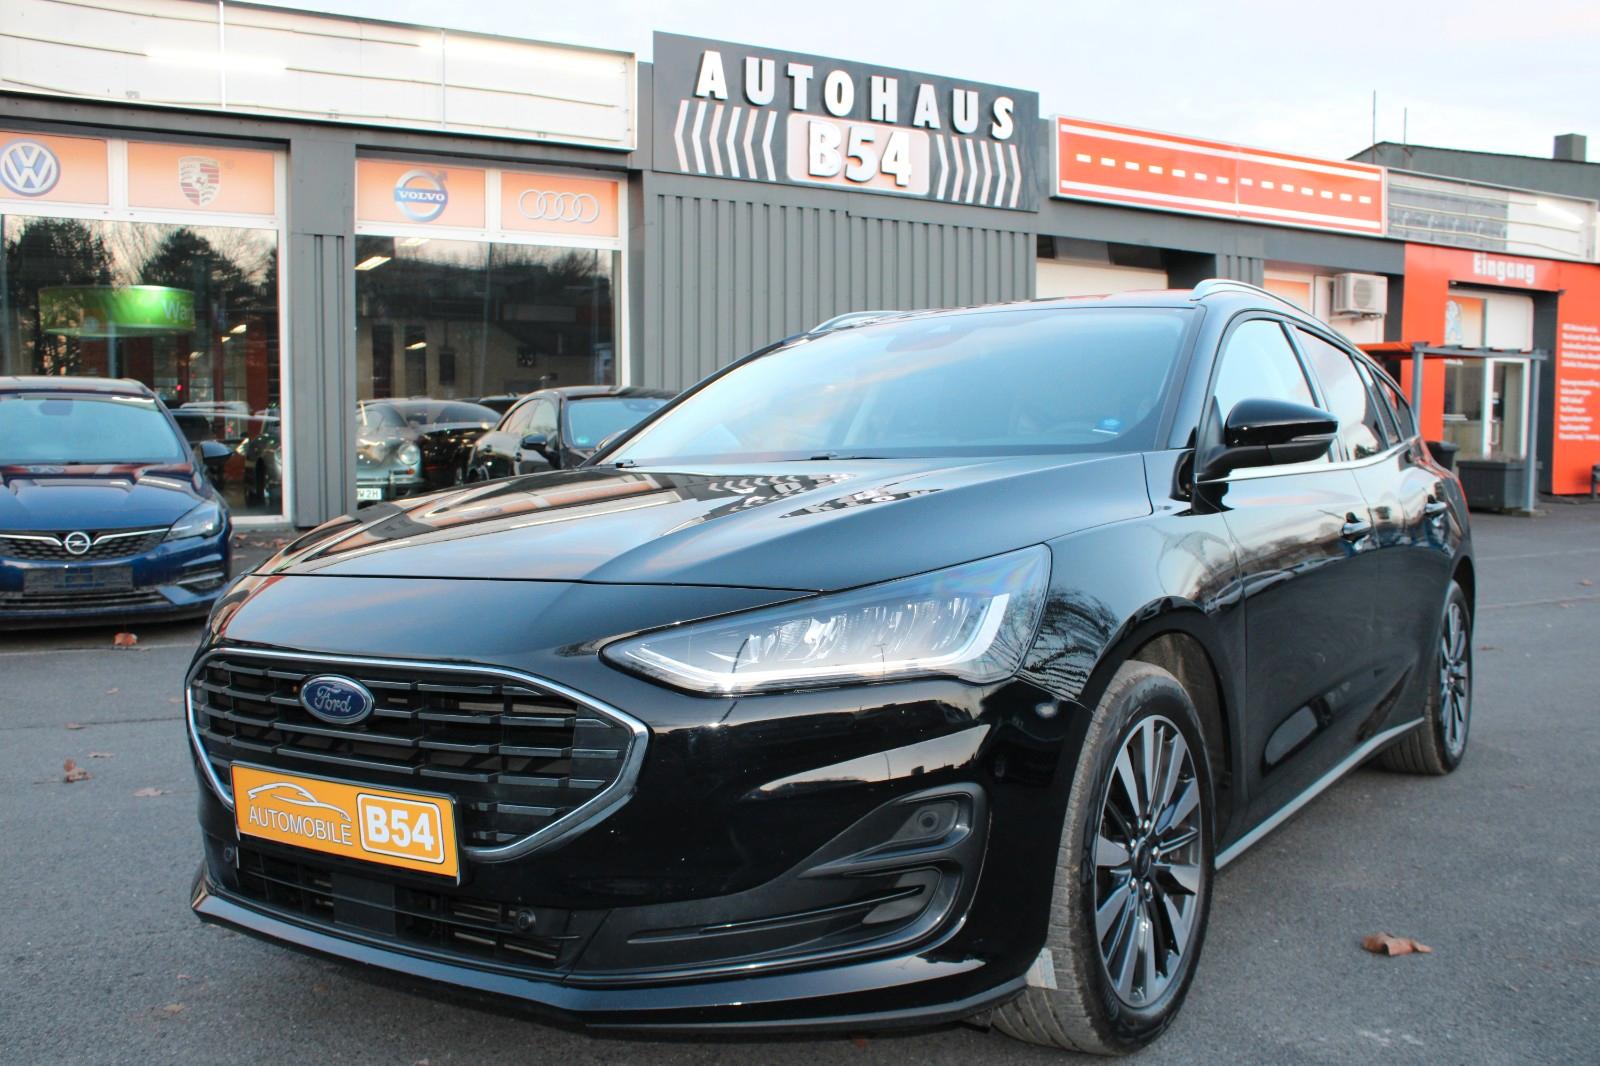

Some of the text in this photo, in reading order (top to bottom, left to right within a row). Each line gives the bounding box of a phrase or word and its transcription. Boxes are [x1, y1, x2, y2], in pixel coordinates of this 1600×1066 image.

[694, 50, 1016, 141] AUTOHAUS
[808, 120, 913, 188] B54
[398, 190, 446, 201] VOLVO
[1473, 254, 1535, 284] Eingang
[315, 685, 352, 713] Ford
[248, 804, 353, 846] AUTOMOBILE
[366, 804, 435, 852] B54
